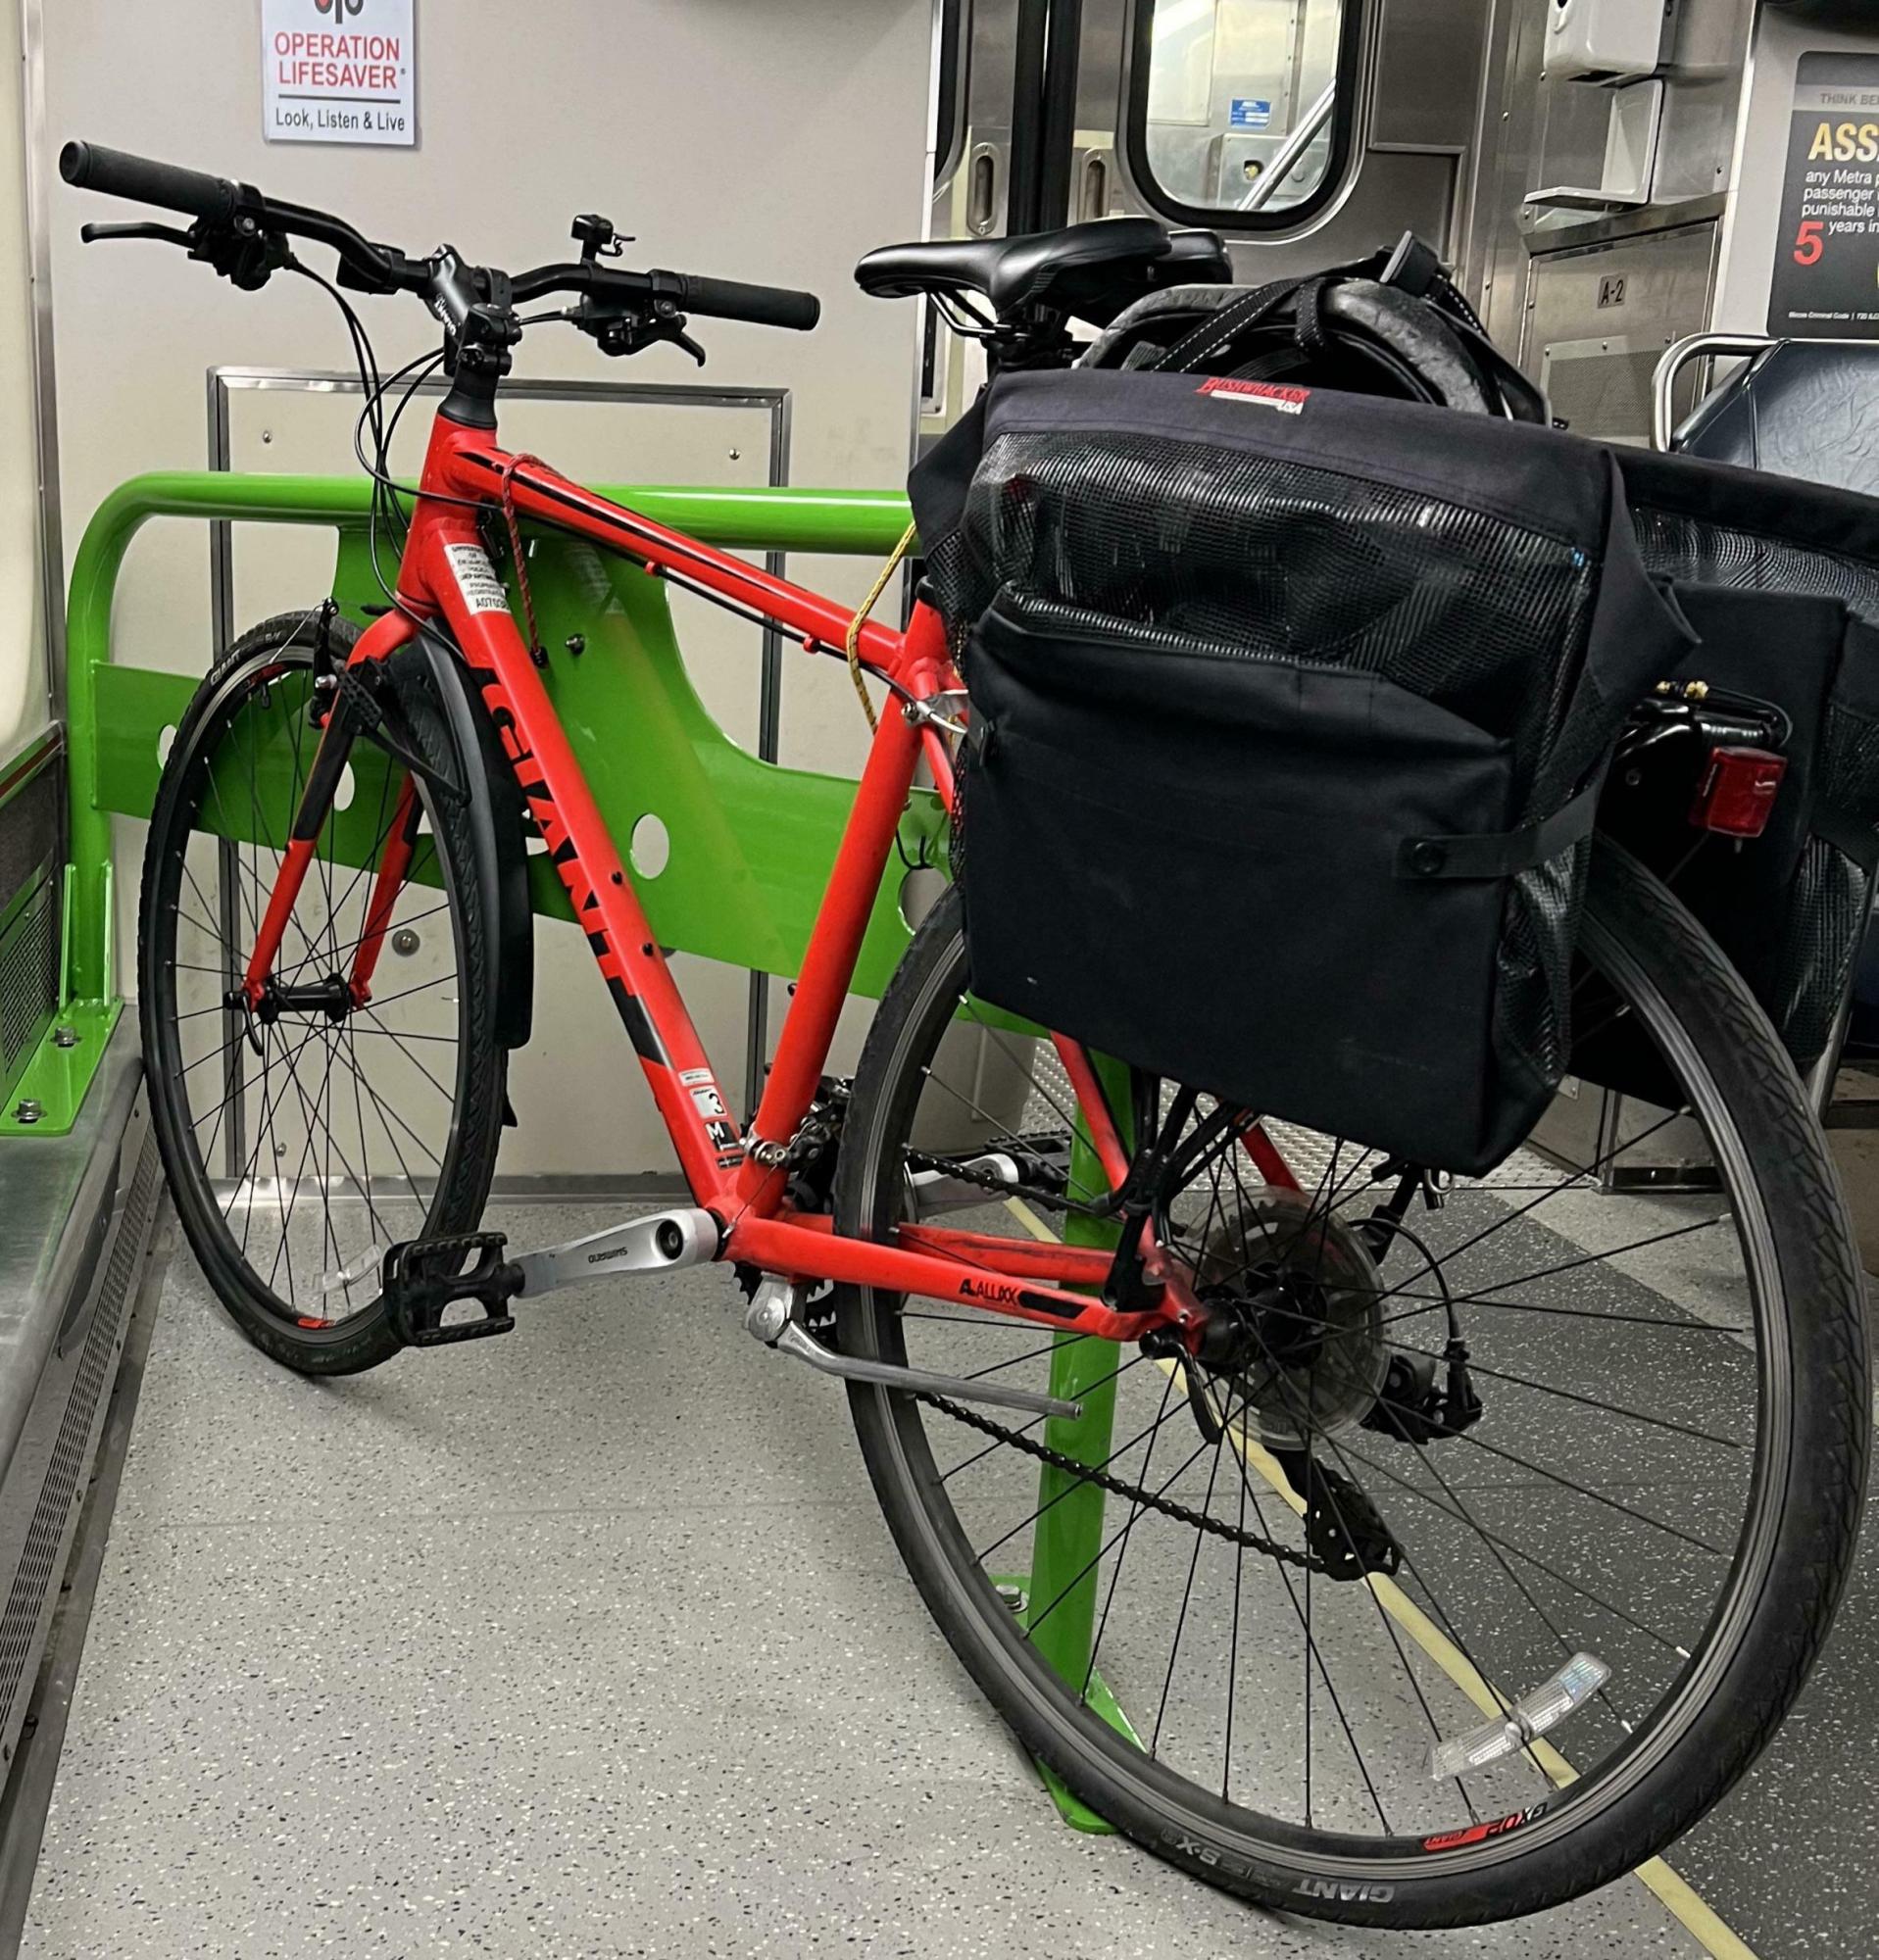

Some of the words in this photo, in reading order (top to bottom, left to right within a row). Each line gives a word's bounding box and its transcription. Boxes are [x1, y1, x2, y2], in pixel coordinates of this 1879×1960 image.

[274, 31, 400, 61] OPERATION
[275, 108, 314, 130] Look,
[318, 109, 359, 128] Listen
[363, 111, 372, 129] &
[377, 112, 405, 131] Live
[1807, 122, 1879, 163] ASS
[1805, 171, 1831, 186] any
[1833, 169, 1872, 184] Metra
[1803, 187, 1875, 204] passenger
[1802, 201, 1875, 218] punishable
[1793, 220, 1824, 266] 5
[1828, 220, 1866, 235] years
[1600, 279, 1624, 304] A-2
[481, 683, 644, 997] GIANT
[1291, 1878, 1396, 1903] GIANT
